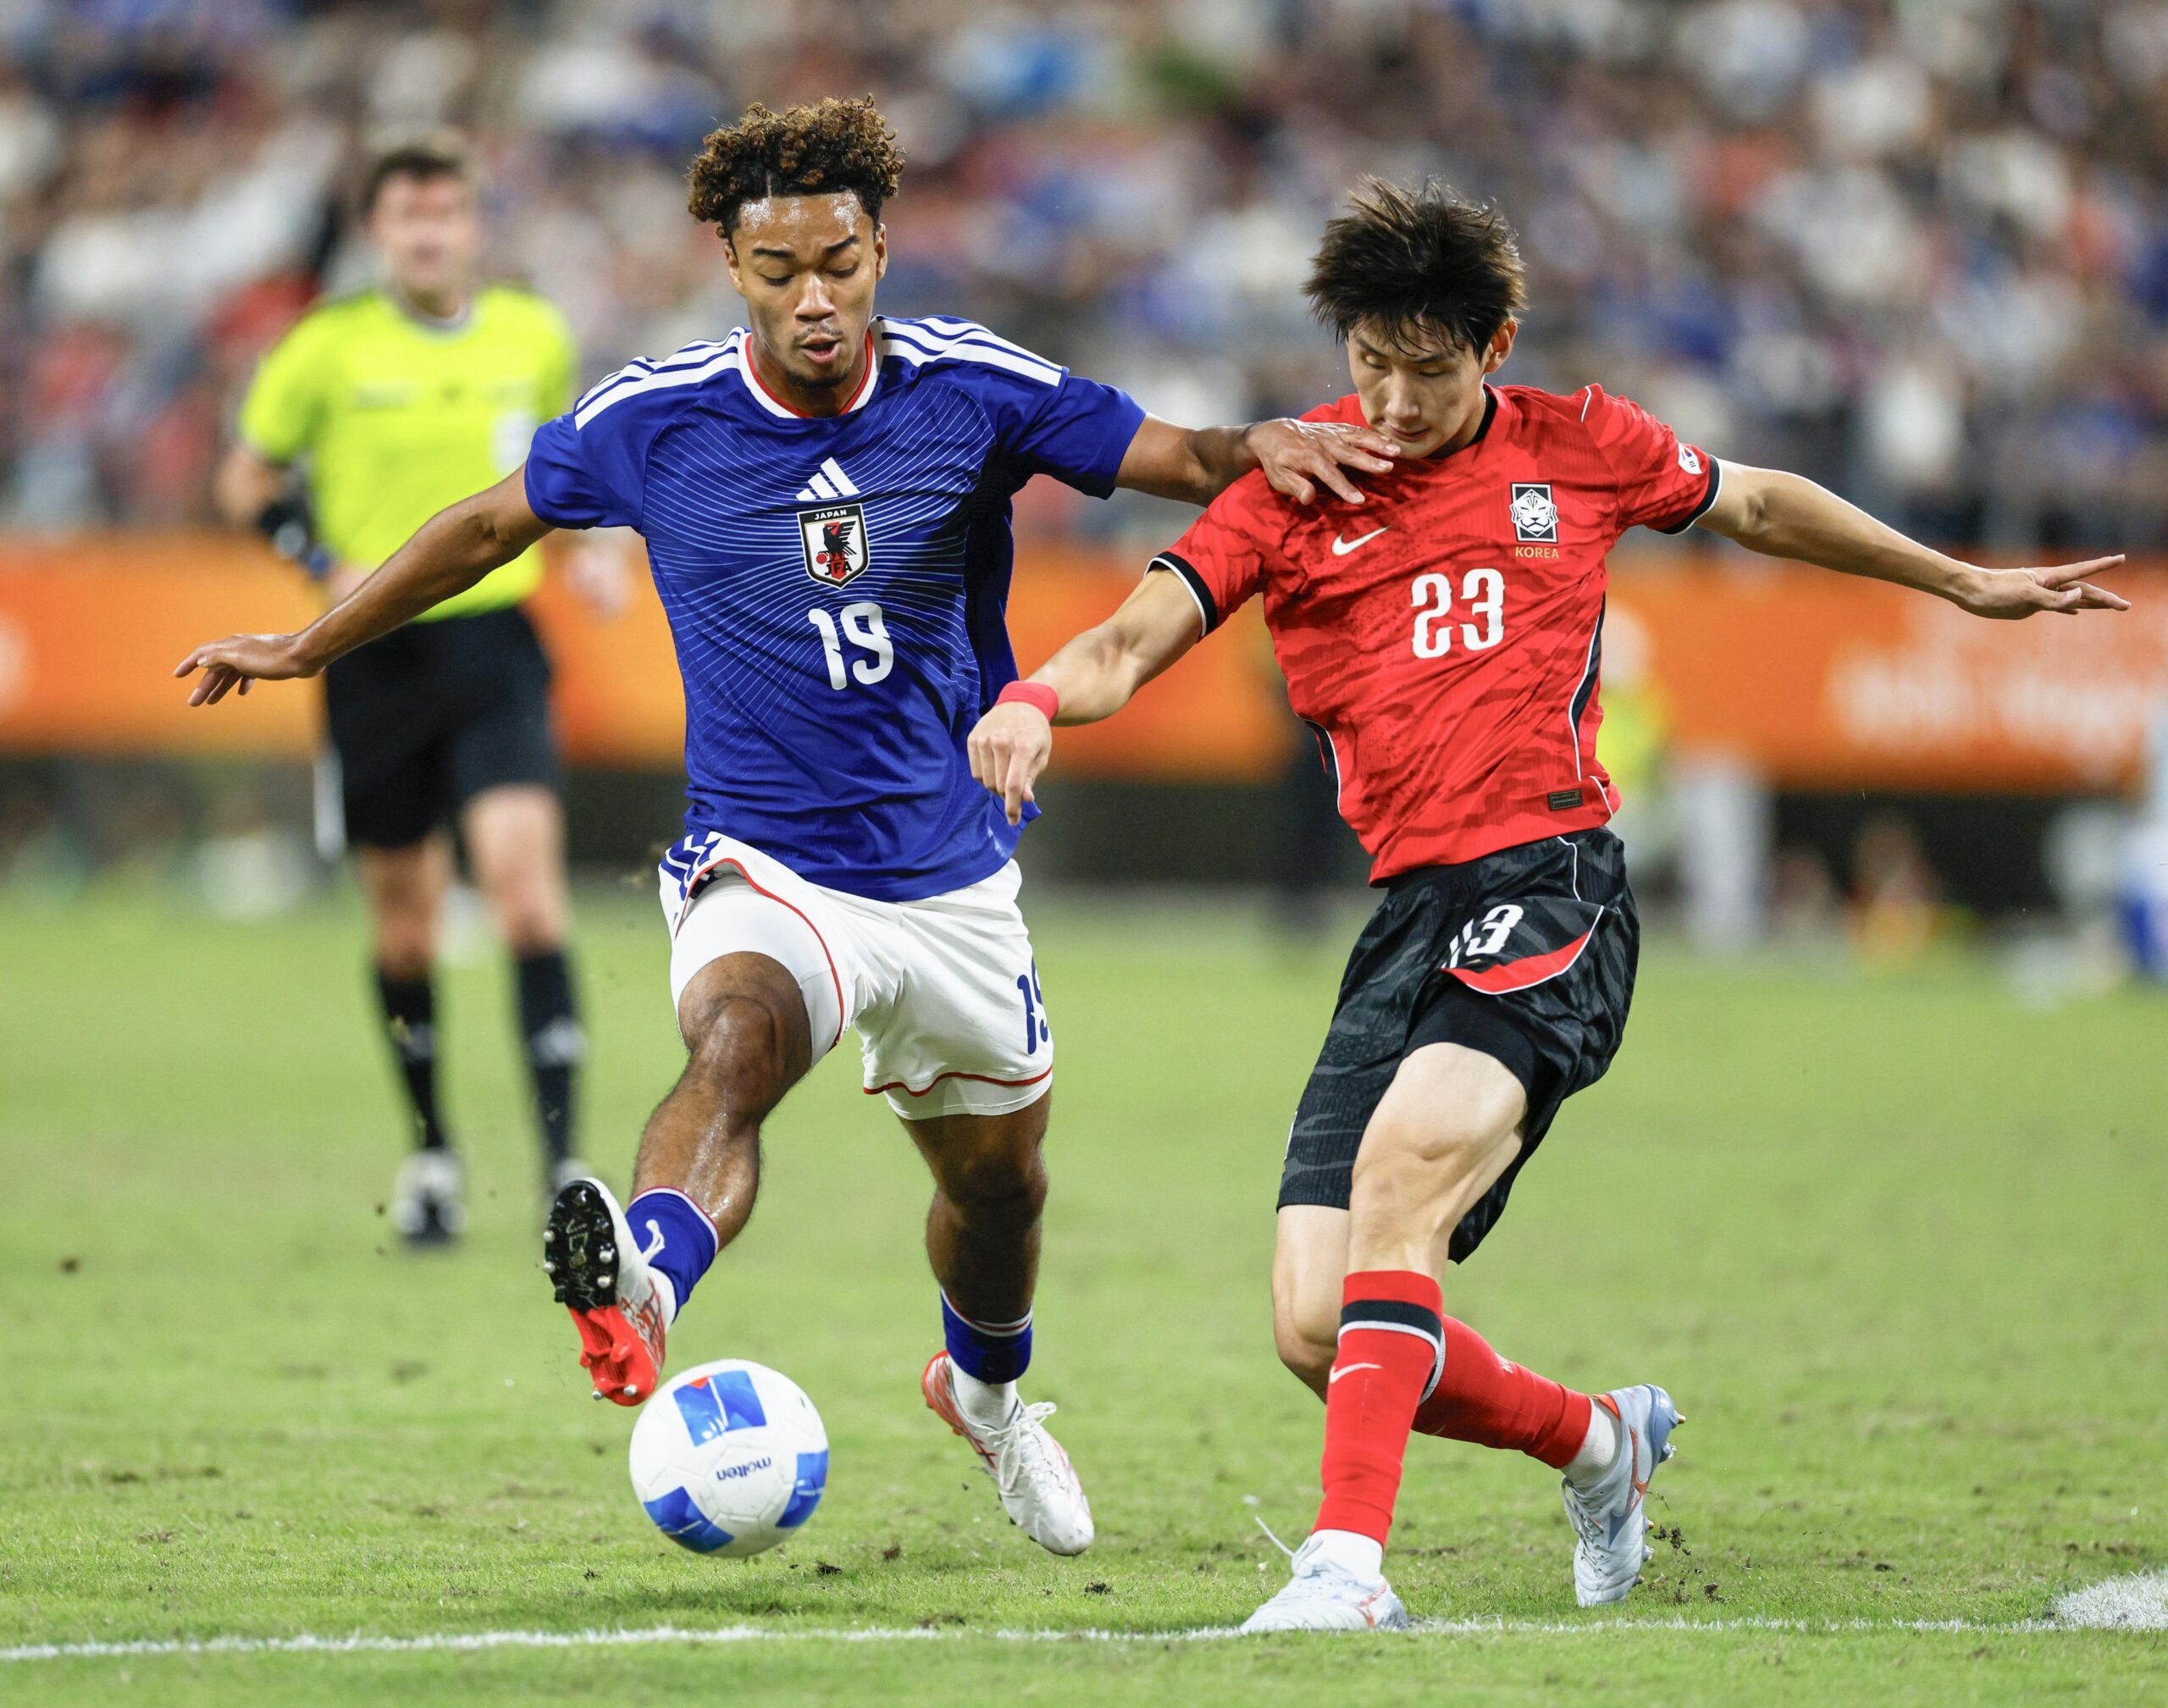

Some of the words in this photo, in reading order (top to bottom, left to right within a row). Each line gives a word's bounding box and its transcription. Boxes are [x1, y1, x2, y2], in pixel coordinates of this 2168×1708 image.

[814, 509, 847, 521] JAPAN
[1515, 546, 1559, 559] KOREA
[825, 561, 852, 575] JFA
[1410, 568, 1505, 659] 23
[808, 602, 894, 690] 19
[716, 1456, 772, 1480] molten
